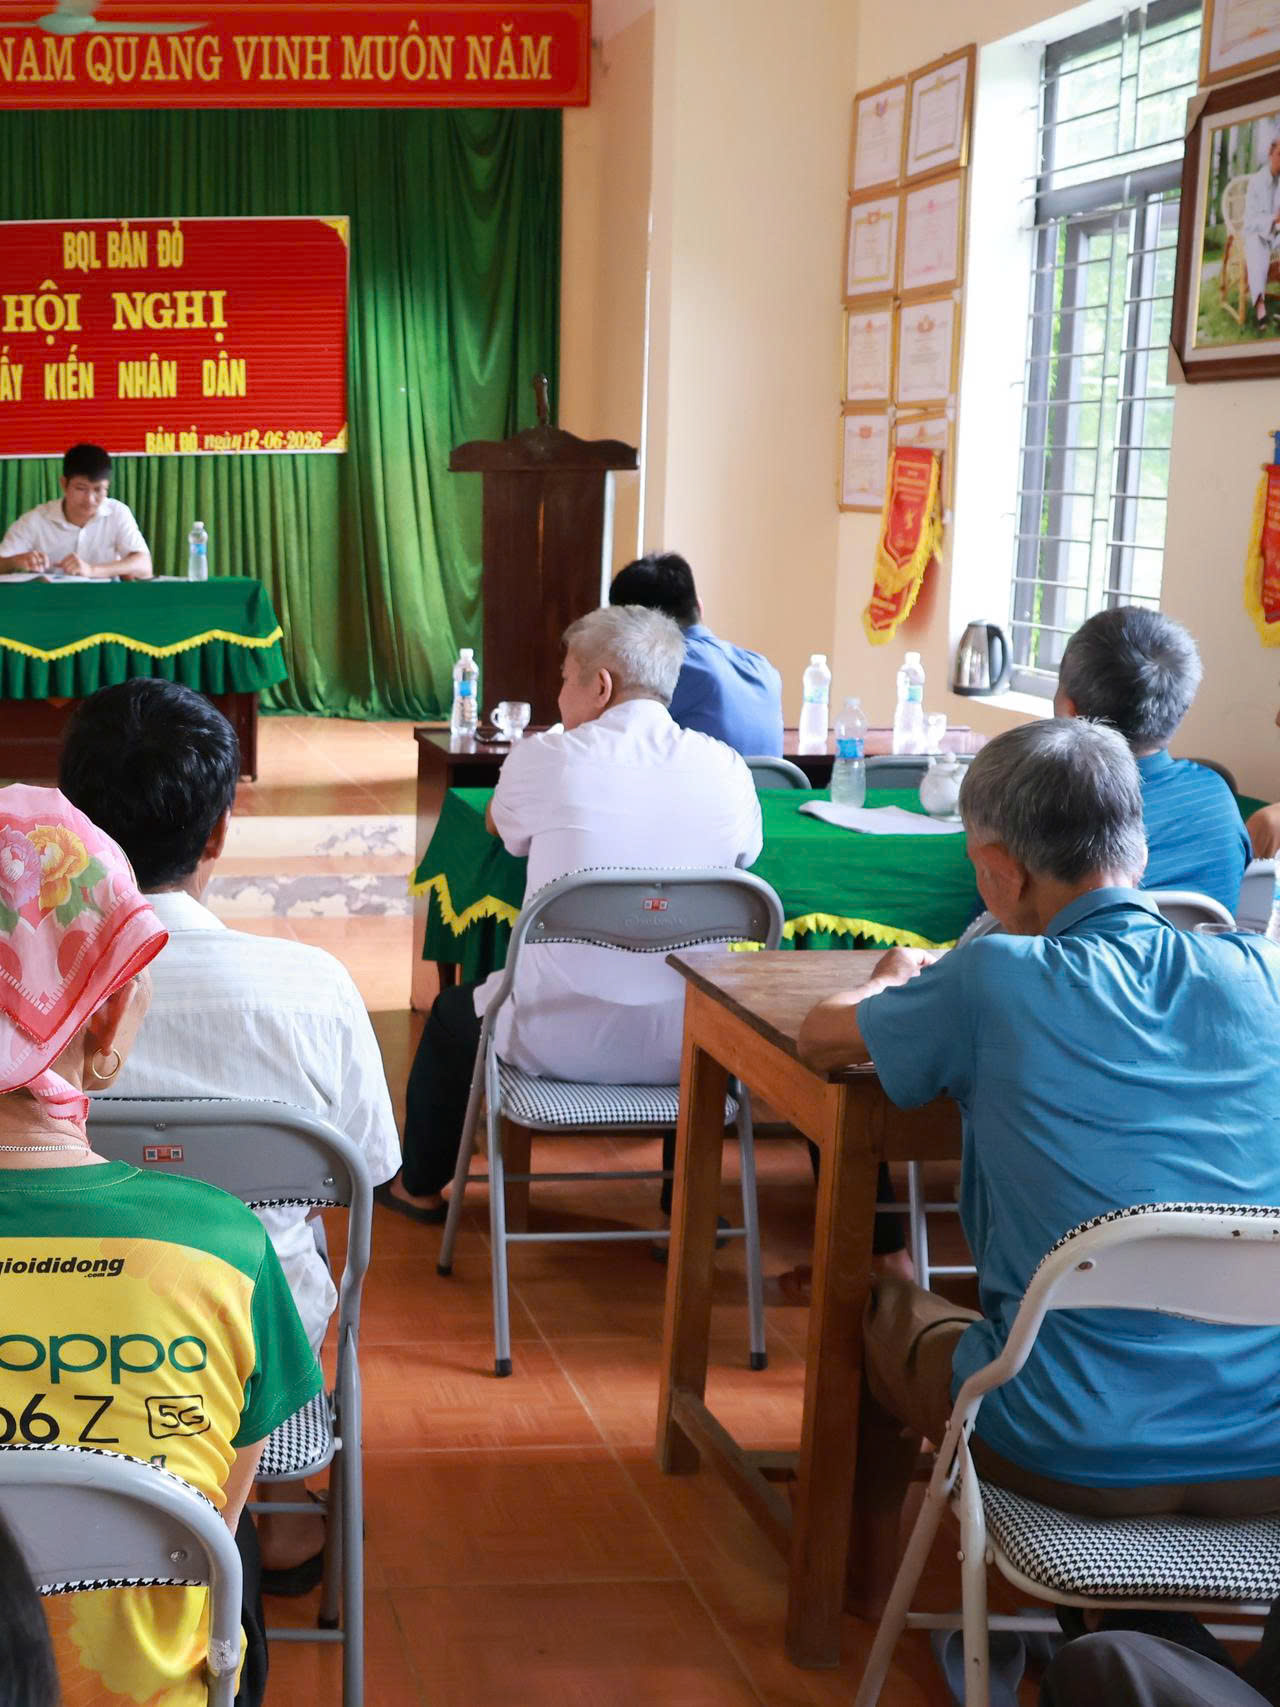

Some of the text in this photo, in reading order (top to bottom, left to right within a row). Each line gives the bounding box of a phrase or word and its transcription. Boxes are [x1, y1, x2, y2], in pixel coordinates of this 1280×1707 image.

[85, 35, 223, 85] QUANG
[233, 35, 332, 81] VINH
[341, 19, 455, 81] MUÔN
[465, 22, 553, 81] NĂM
[63, 230, 102, 274] BQL
[107, 219, 148, 269] BẢN
[2, 279, 228, 345] HỘI NGHỊ
[44, 344, 95, 400] KIẾN
[118, 351, 178, 399] NHÂN
[202, 349, 246, 398] DÂN
[73, 1394, 120, 1444] Z
[159, 1404, 206, 1429] 5G
